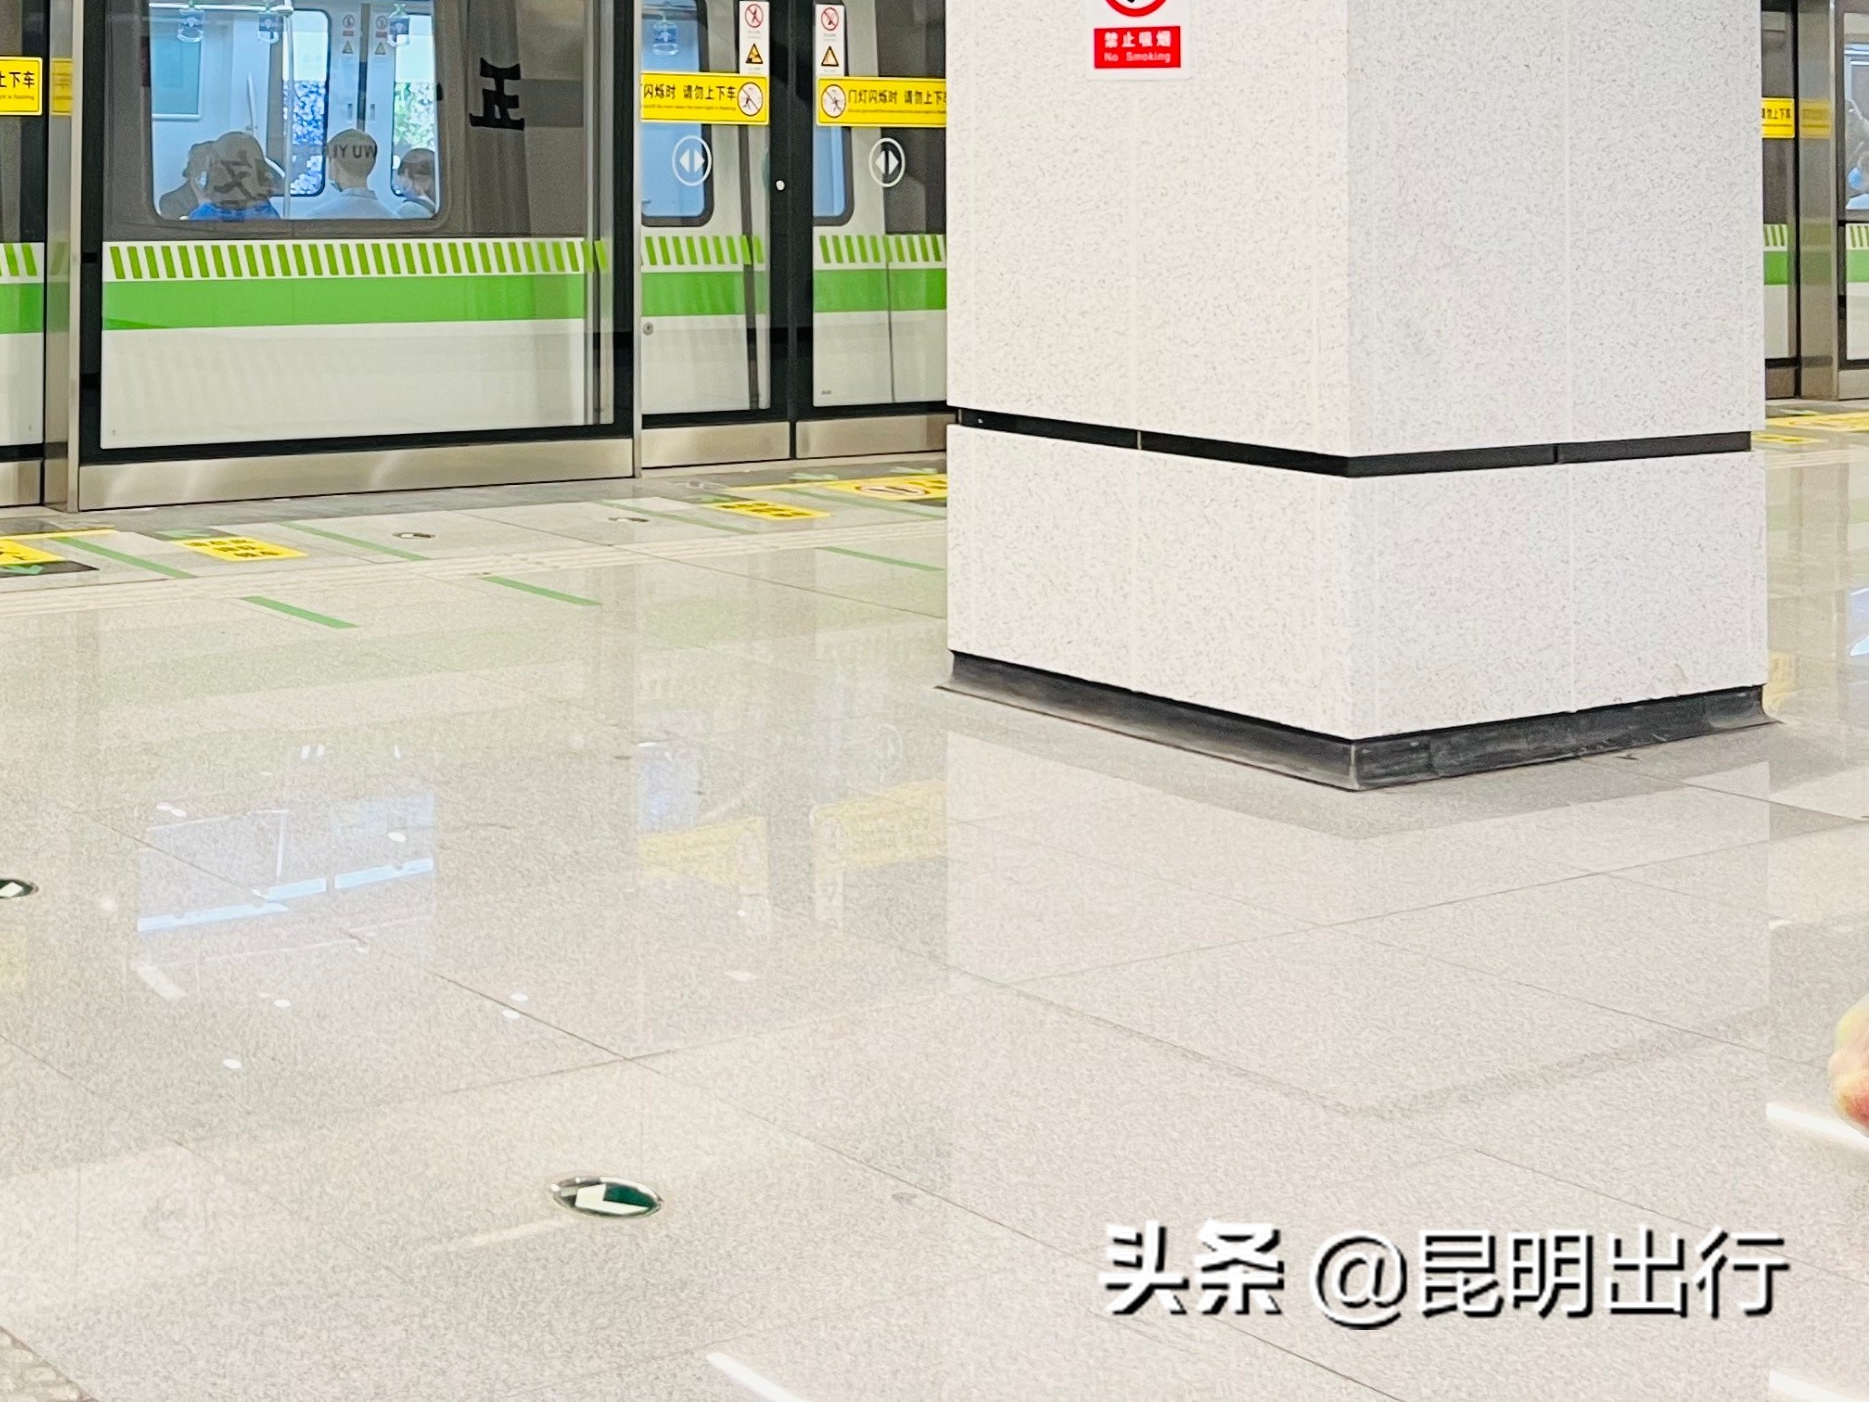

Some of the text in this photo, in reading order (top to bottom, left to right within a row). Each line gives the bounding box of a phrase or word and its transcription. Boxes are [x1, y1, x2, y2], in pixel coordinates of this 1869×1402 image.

[1125, 51, 1171, 64] Smoking
[641, 82, 737, 102] 闪烁时 请勿上下车
[847, 89, 898, 105] 门灯闪烁时
